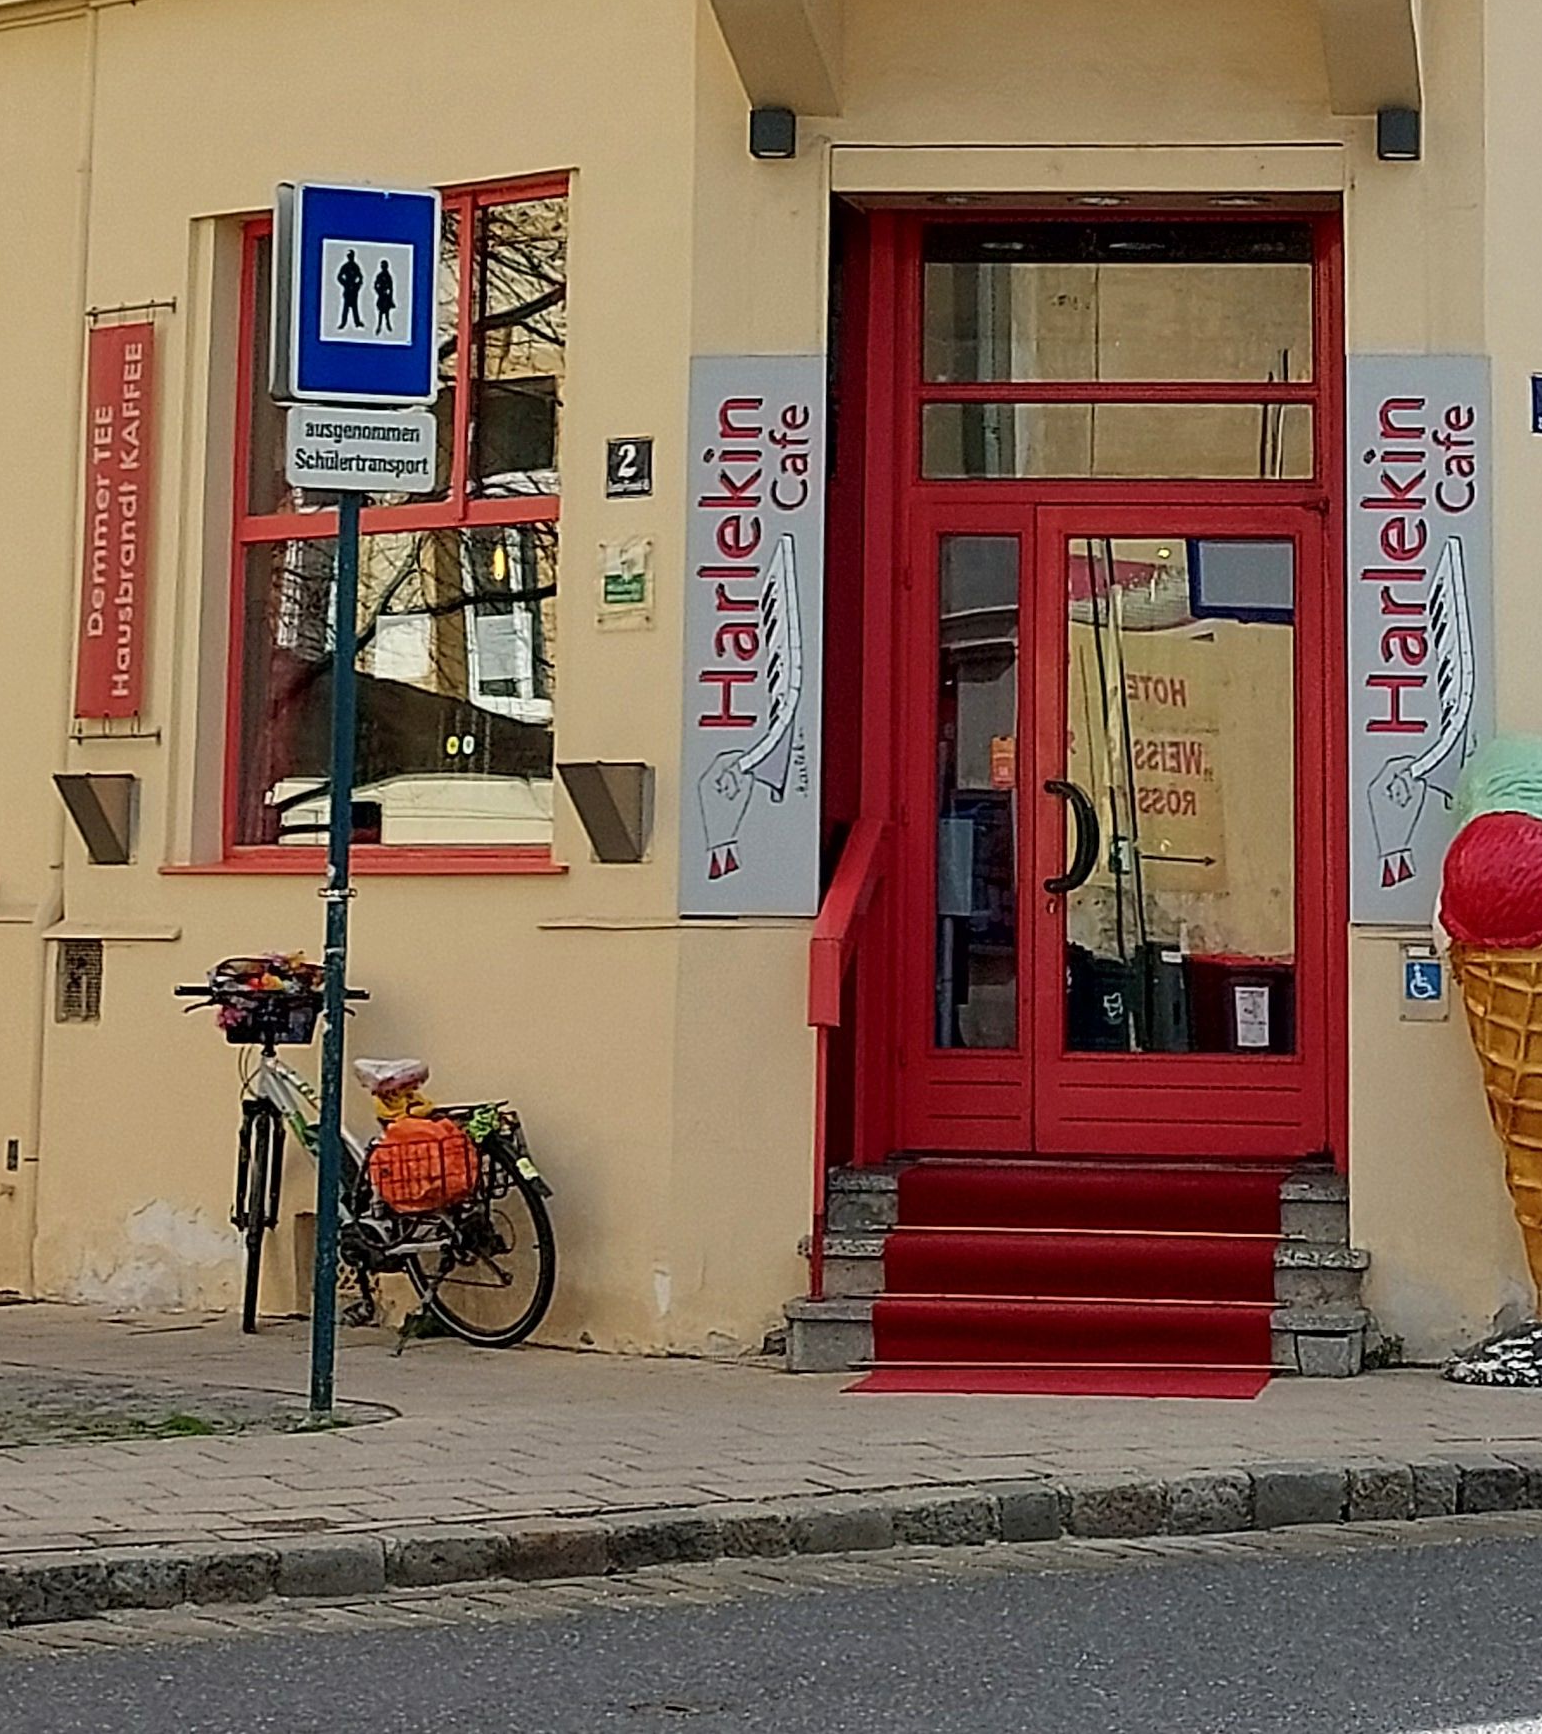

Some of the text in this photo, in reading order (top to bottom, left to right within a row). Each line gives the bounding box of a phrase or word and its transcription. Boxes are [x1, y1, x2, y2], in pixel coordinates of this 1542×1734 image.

[294, 448, 429, 479] Schülertransport
[305, 422, 420, 444] ausgenommen
[617, 444, 637, 477] 2
[769, 403, 810, 511] Cafe
[1434, 404, 1476, 514] Cafe
[87, 405, 114, 637] Demmer TEE
[112, 342, 143, 697] Hausbrandt KAFFEE
[698, 397, 763, 728] Harlekin
[1360, 397, 1428, 734] Harlekin
